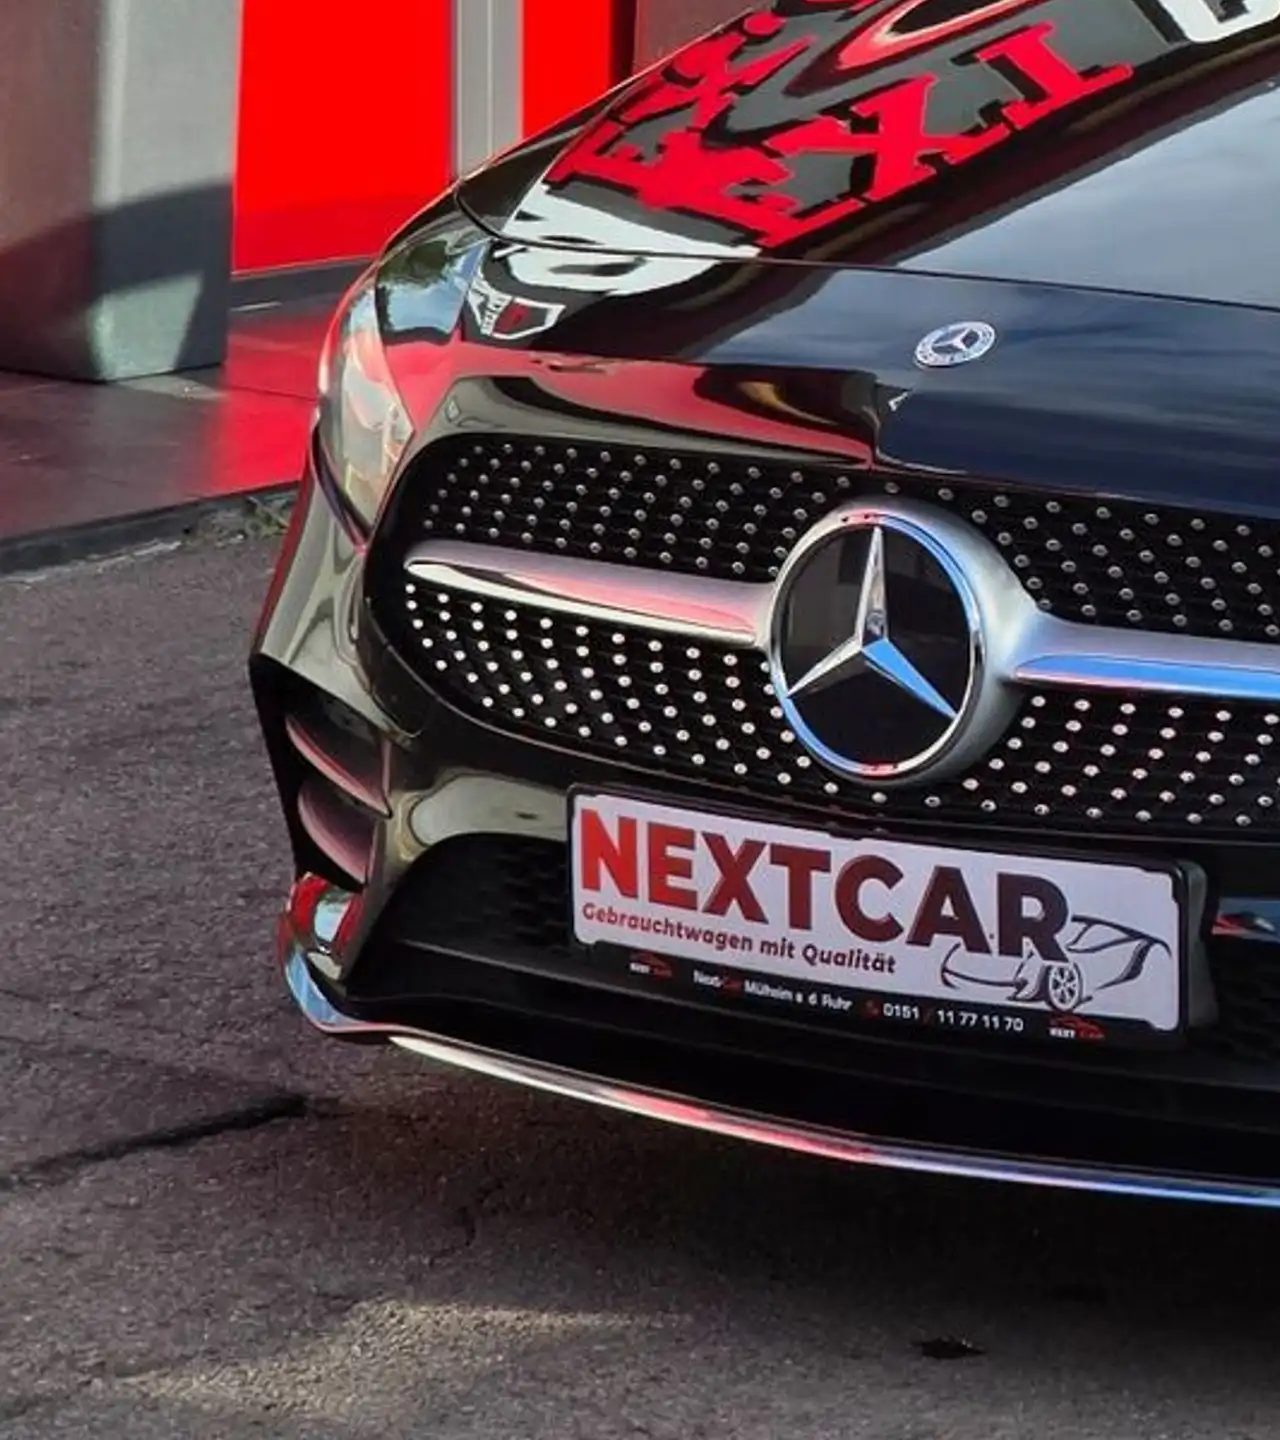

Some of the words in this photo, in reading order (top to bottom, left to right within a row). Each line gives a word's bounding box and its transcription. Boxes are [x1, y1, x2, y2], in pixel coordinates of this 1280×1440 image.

[581, 808, 1069, 963] NEXTCAR
[582, 902, 753, 952] Gebrauchtwagen
[760, 936, 796, 960] mit
[802, 943, 897, 974] Qualität
[883, 1002, 920, 1020] 0151
[937, 1009, 955, 1024] 11
[959, 1012, 977, 1027] 77
[983, 1014, 1000, 1029] 11
[1004, 1016, 1023, 1032] 70
